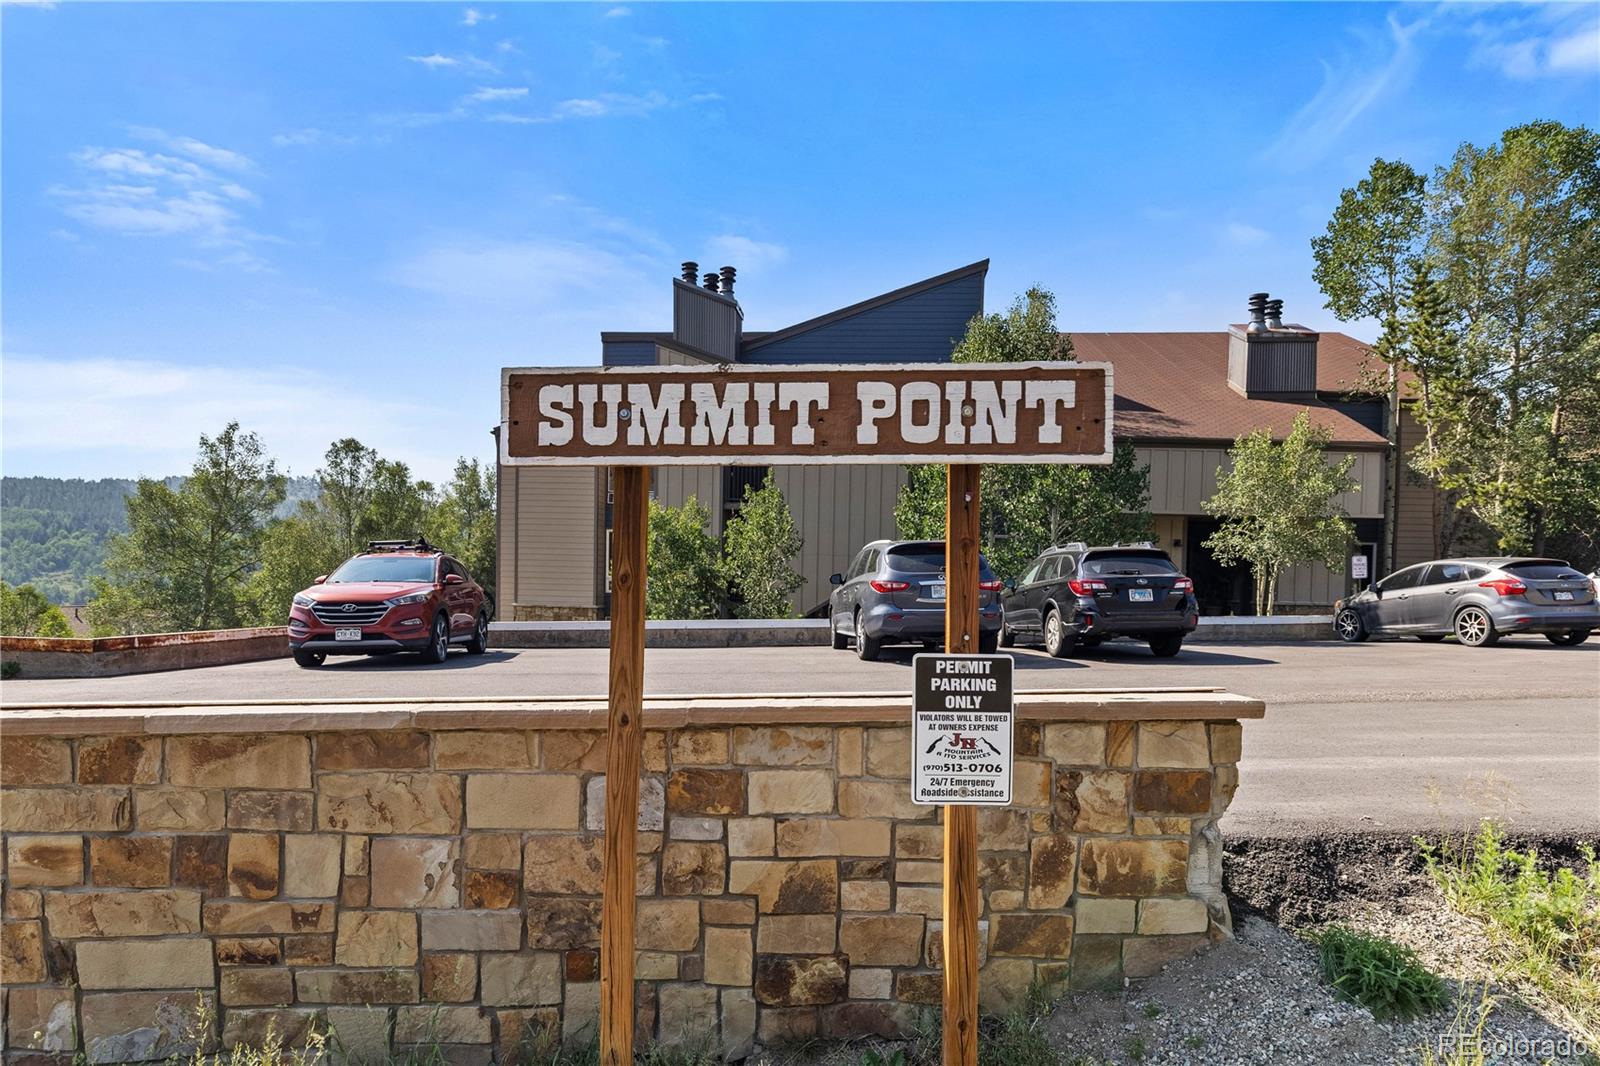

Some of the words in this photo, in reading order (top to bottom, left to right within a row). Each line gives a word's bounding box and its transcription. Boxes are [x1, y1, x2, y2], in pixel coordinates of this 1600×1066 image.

[537, 381, 830, 447] SUMMIT
[856, 380, 1077, 445] POINT
[936, 660, 993, 674] PERMIT
[931, 678, 997, 692] PARKING
[945, 695, 983, 709] ONLY
[919, 714, 955, 722] VIOLATORS
[956, 714, 973, 722] WILL
[974, 714, 983, 722] BE
[985, 714, 1008, 722] TOWED
[928, 723, 936, 731] AT
[938, 723, 967, 731] OWNERS
[968, 723, 999, 732] EXPENSE
[958, 751, 991, 760] SERVICES
[923, 763, 1003, 773] (970)513-0706
[930, 777, 949, 786] 24/7
[950, 777, 996, 788] Emergency
[920, 787, 958, 797] Roadside
[960, 788, 1004, 798] sistance
